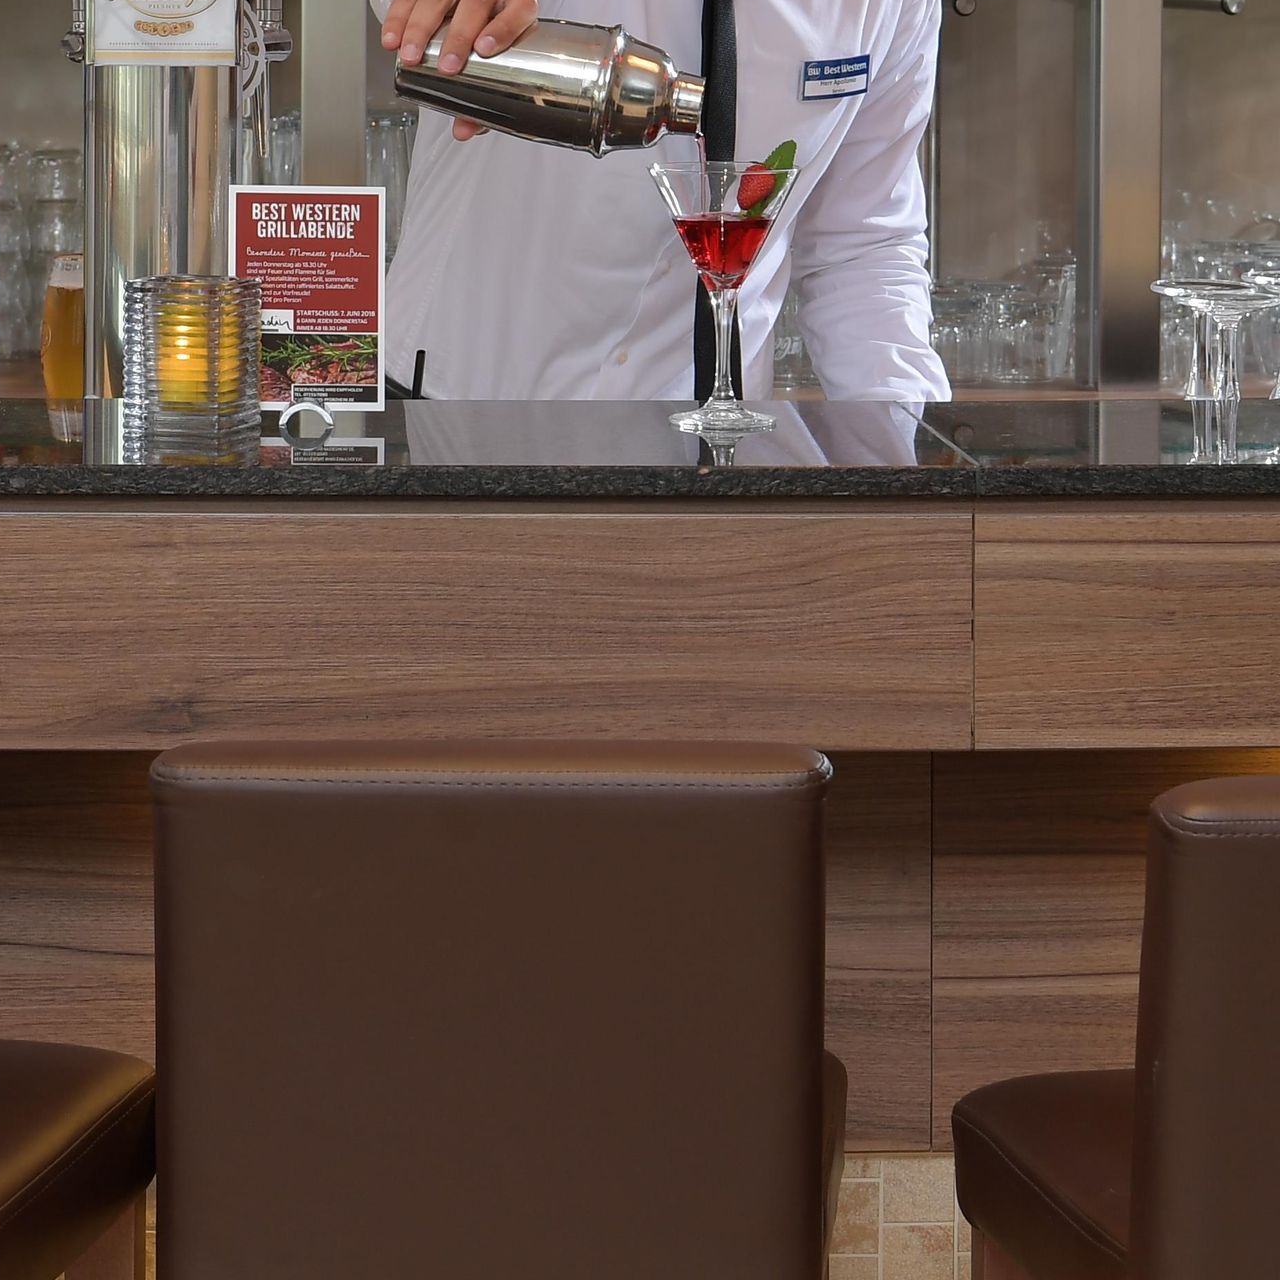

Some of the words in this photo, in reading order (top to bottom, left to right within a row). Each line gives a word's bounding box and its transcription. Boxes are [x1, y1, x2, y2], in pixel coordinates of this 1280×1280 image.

[824, 65, 841, 75] Best
[841, 62, 867, 73] Western
[252, 203, 287, 220] BEST
[292, 204, 360, 221] WESTERN
[257, 221, 355, 239] GRILLABENDE
[246, 246, 286, 257] Besondere
[289, 247, 327, 257] Momente
[263, 261, 294, 269] Donnerstag
[265, 275, 299, 283] Spezialitäten
